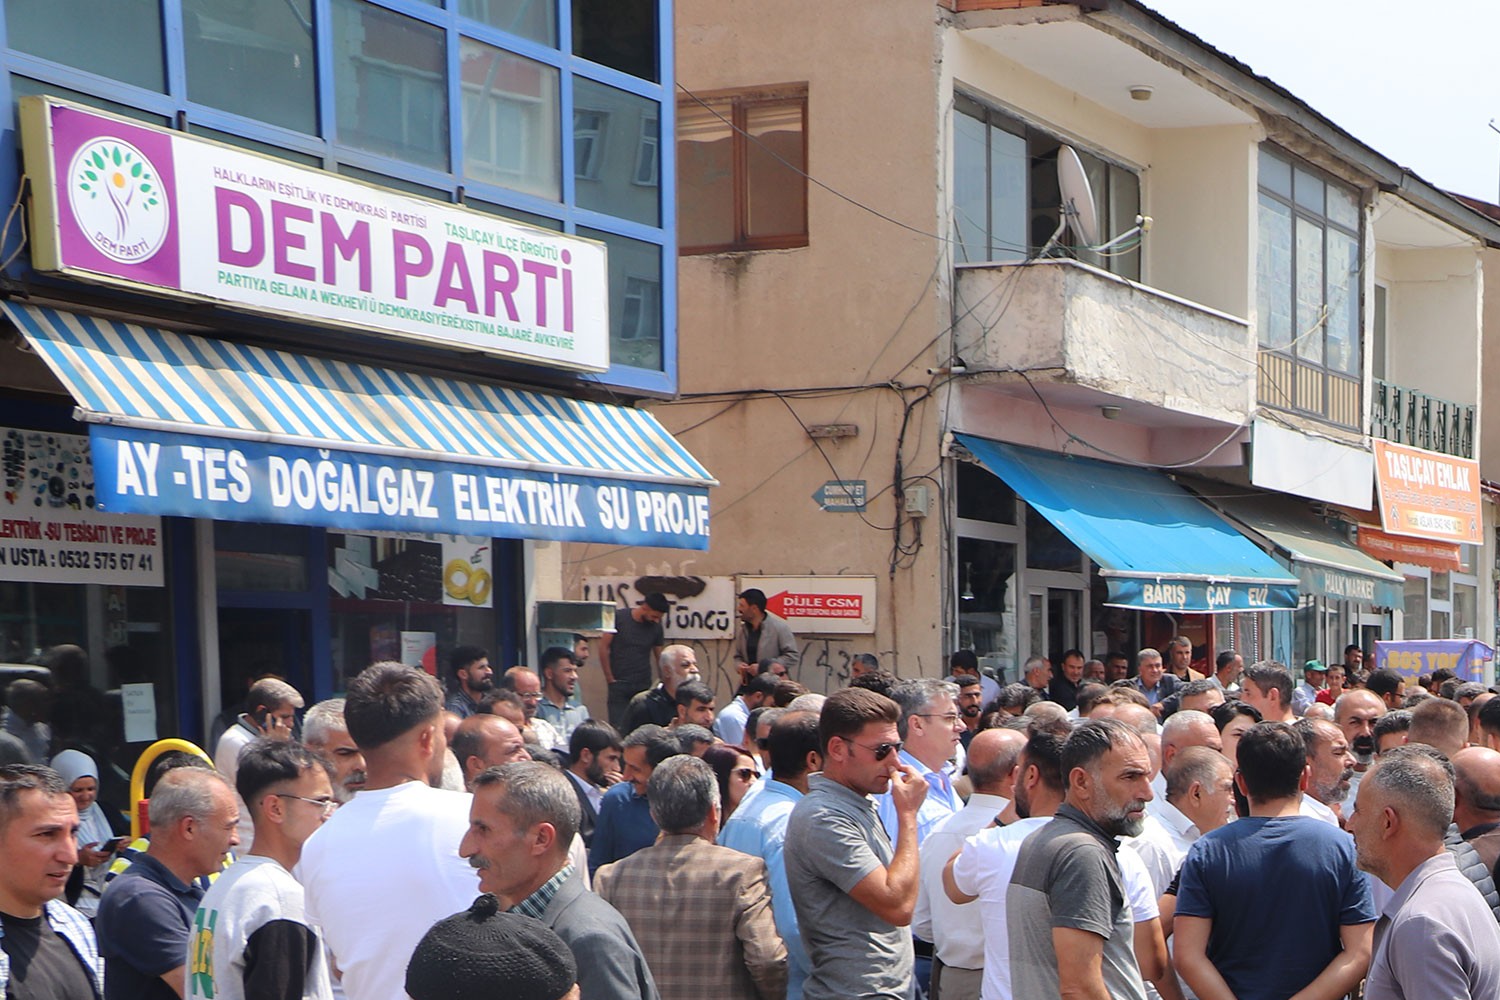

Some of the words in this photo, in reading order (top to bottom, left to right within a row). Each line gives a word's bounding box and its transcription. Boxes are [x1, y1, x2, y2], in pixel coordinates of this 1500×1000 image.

[214, 166, 276, 193] HALKLARIN
[278, 182, 317, 203] EŞİTLİK
[320, 193, 333, 206] VE
[334, 196, 388, 219] DEMOKRASİ
[391, 211, 428, 229] PARTİSİ
[94, 231, 117, 253] DEM
[444, 222, 494, 245] TAŞLIÇAY
[497, 232, 519, 253] İLÇE
[520, 237, 558, 261] ÖRGÜTÜ
[214, 186, 373, 294] DEM
[392, 229, 574, 333] PARTİ
[270, 280, 309, 300] GELAN
[1385, 450, 1437, 490] TAŞLIÇAY
[1436, 461, 1471, 493] EMLAK
[116, 439, 161, 497] AY
[268, 449, 439, 519] DOĞALGAZ
[452, 472, 586, 529] ELEKTRİK
[597, 485, 630, 531] SU
[64, 520, 109, 544] TESİSATI
[110, 526, 124, 545] VE
[125, 527, 157, 547] PROJE
[10, 548, 48, 567] USTA
[59, 550, 91, 569] 0532
[94, 551, 117, 570] 575
[120, 553, 135, 571] 67
[139, 554, 153, 571] 41
[1143, 584, 1186, 608] BARIŞ
[1206, 585, 1231, 609] ÇAY
[1248, 584, 1268, 606] EVİ
[1346, 576, 1376, 600] MARKET
[826, 598, 860, 608] GSM
